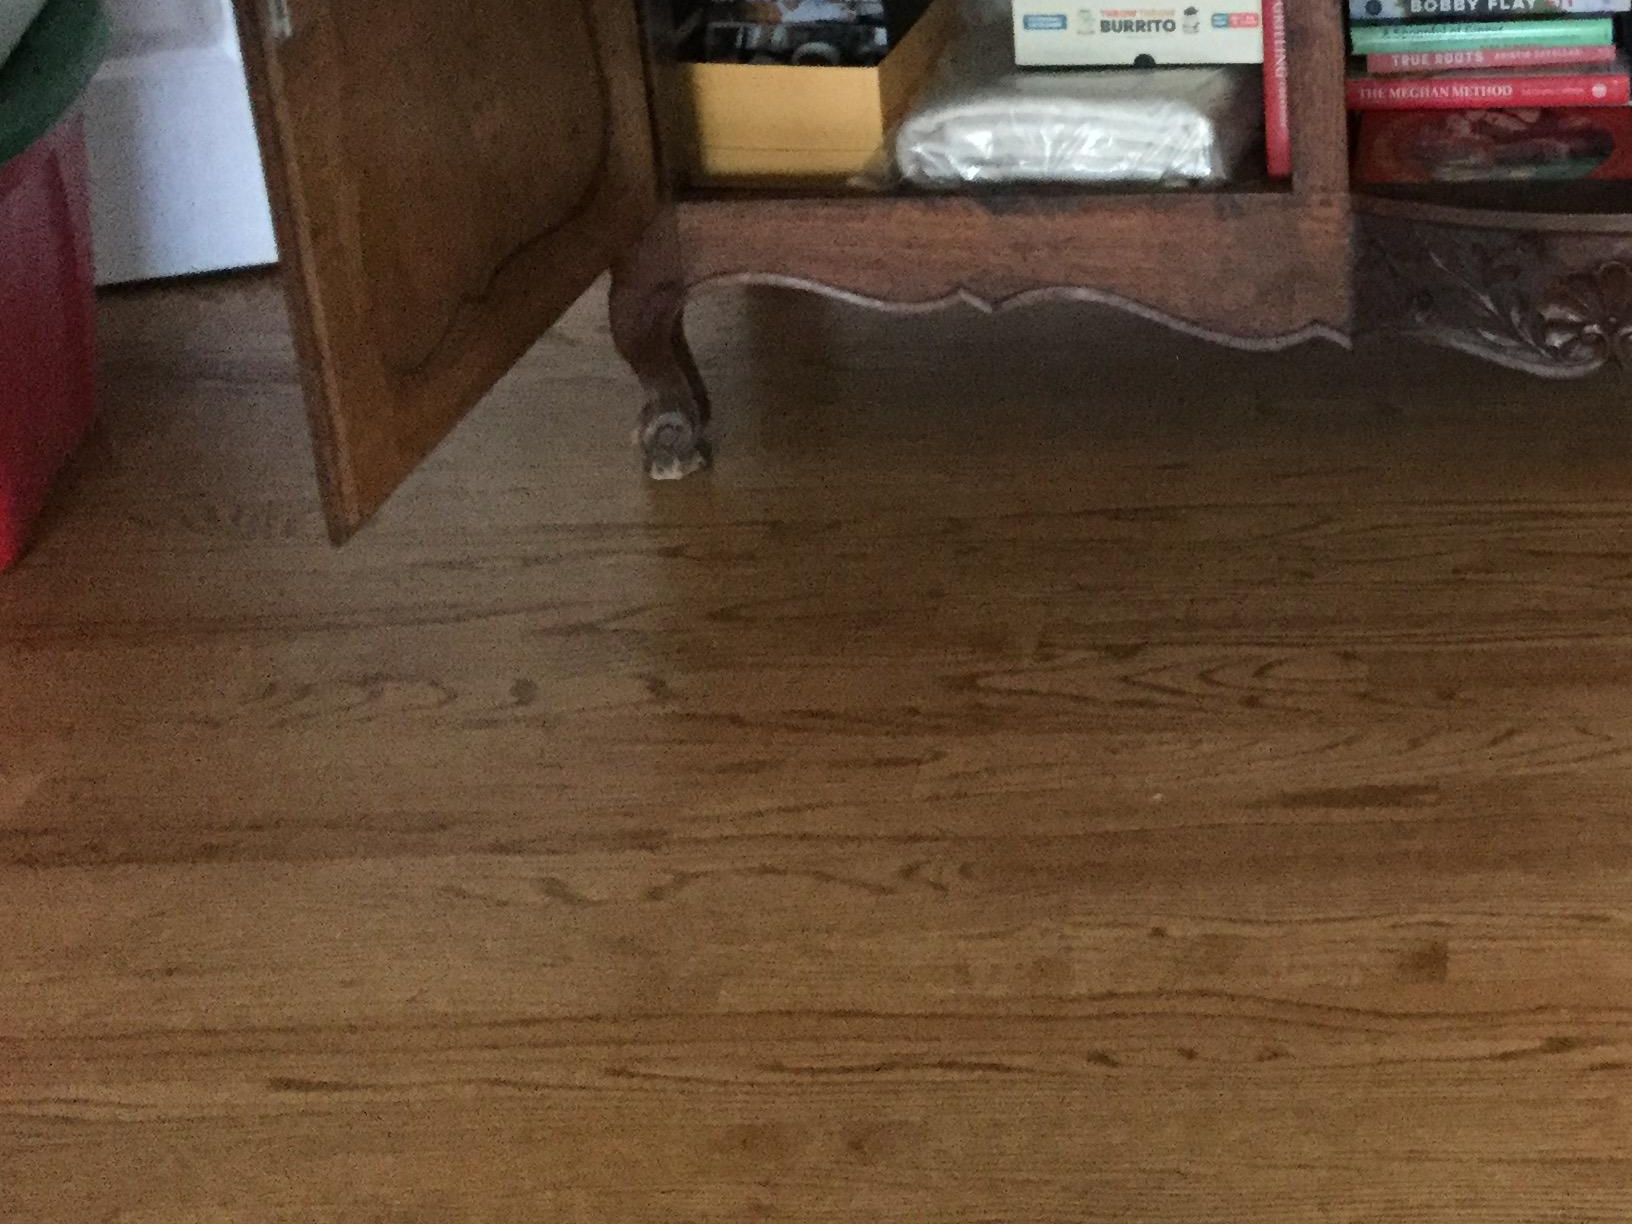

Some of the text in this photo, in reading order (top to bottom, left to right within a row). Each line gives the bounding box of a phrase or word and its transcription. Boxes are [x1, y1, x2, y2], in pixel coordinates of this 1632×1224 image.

[1100, 19, 1177, 33] BURRITO
[1391, 53, 1428, 67] TRUE
[1435, 51, 1485, 66] ROOTS
[1359, 89, 1385, 100] THE
[1388, 86, 1450, 99] MEGHAN
[1451, 85, 1513, 97] METHOD
